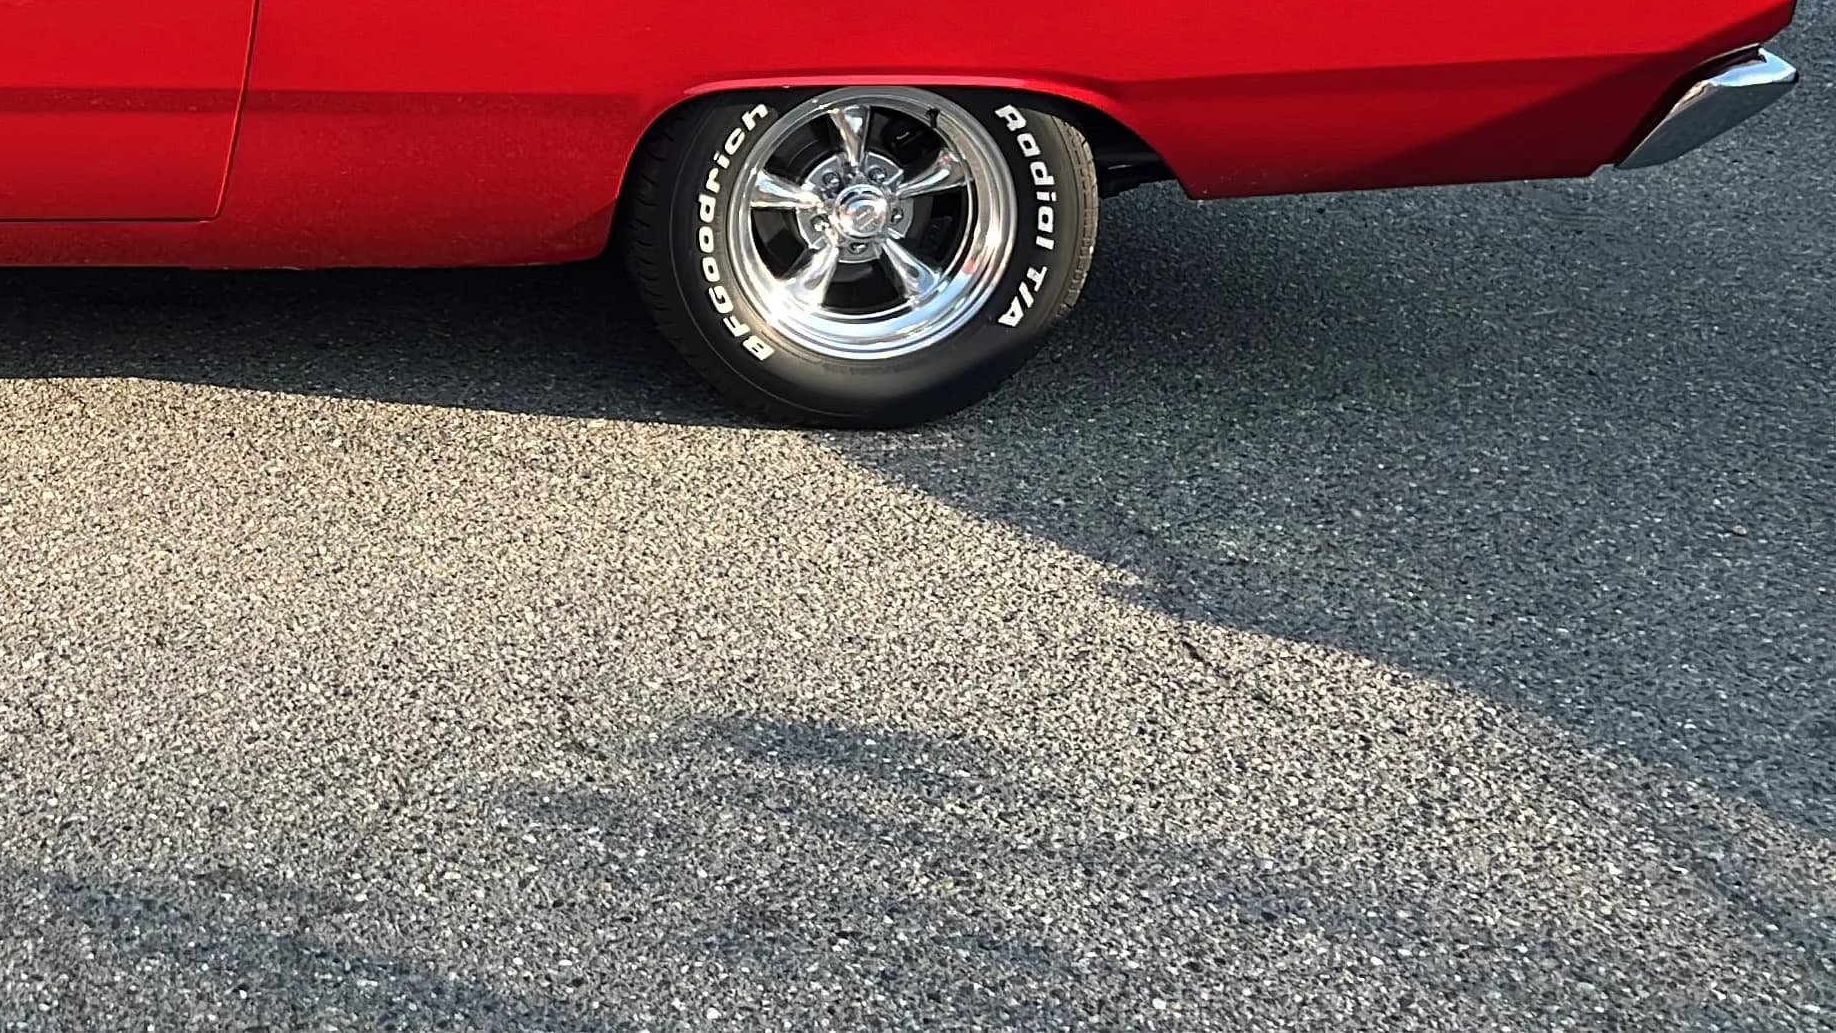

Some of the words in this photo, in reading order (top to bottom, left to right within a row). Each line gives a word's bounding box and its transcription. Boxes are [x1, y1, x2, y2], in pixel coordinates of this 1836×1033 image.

[698, 103, 774, 361] BFGoodrich
[995, 104, 1057, 250] Radial
[997, 265, 1048, 328] T/A
